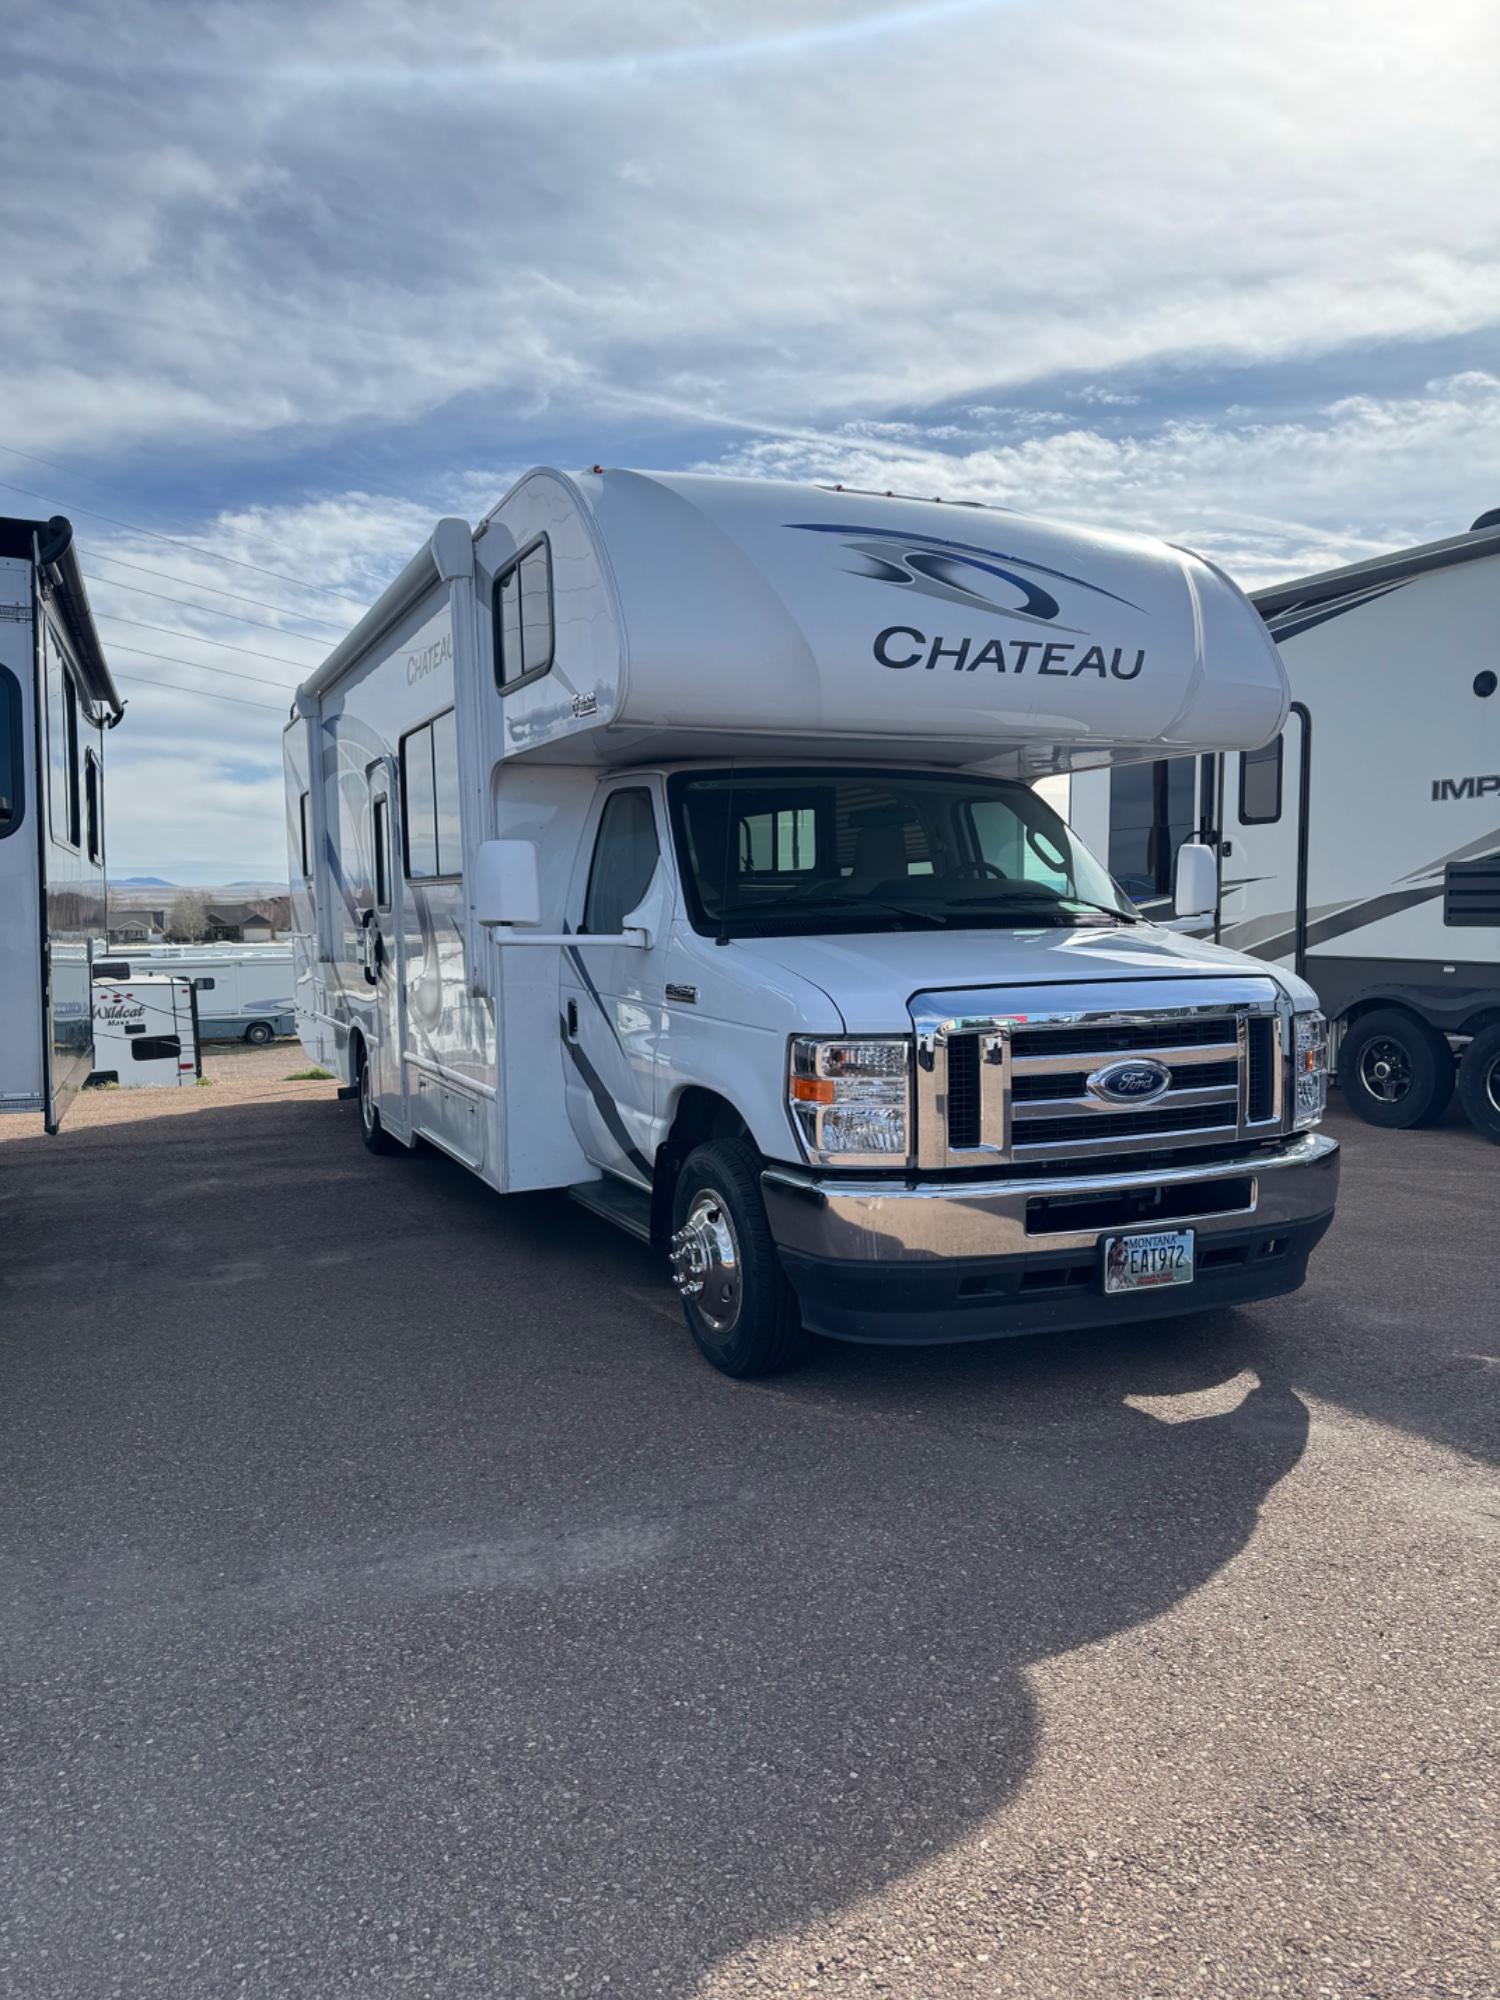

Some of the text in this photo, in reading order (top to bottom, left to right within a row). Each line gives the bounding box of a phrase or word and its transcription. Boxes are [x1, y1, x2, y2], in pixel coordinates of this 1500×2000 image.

[872, 625, 1145, 680] CHATEAU
[1431, 774, 1500, 802] IMP
[92, 1004, 146, 1020] Wildcat
[1118, 1072, 1154, 1091] Ford
[1128, 1234, 1177, 1249] MONTANA
[1130, 1245, 1185, 1274] EAT972
